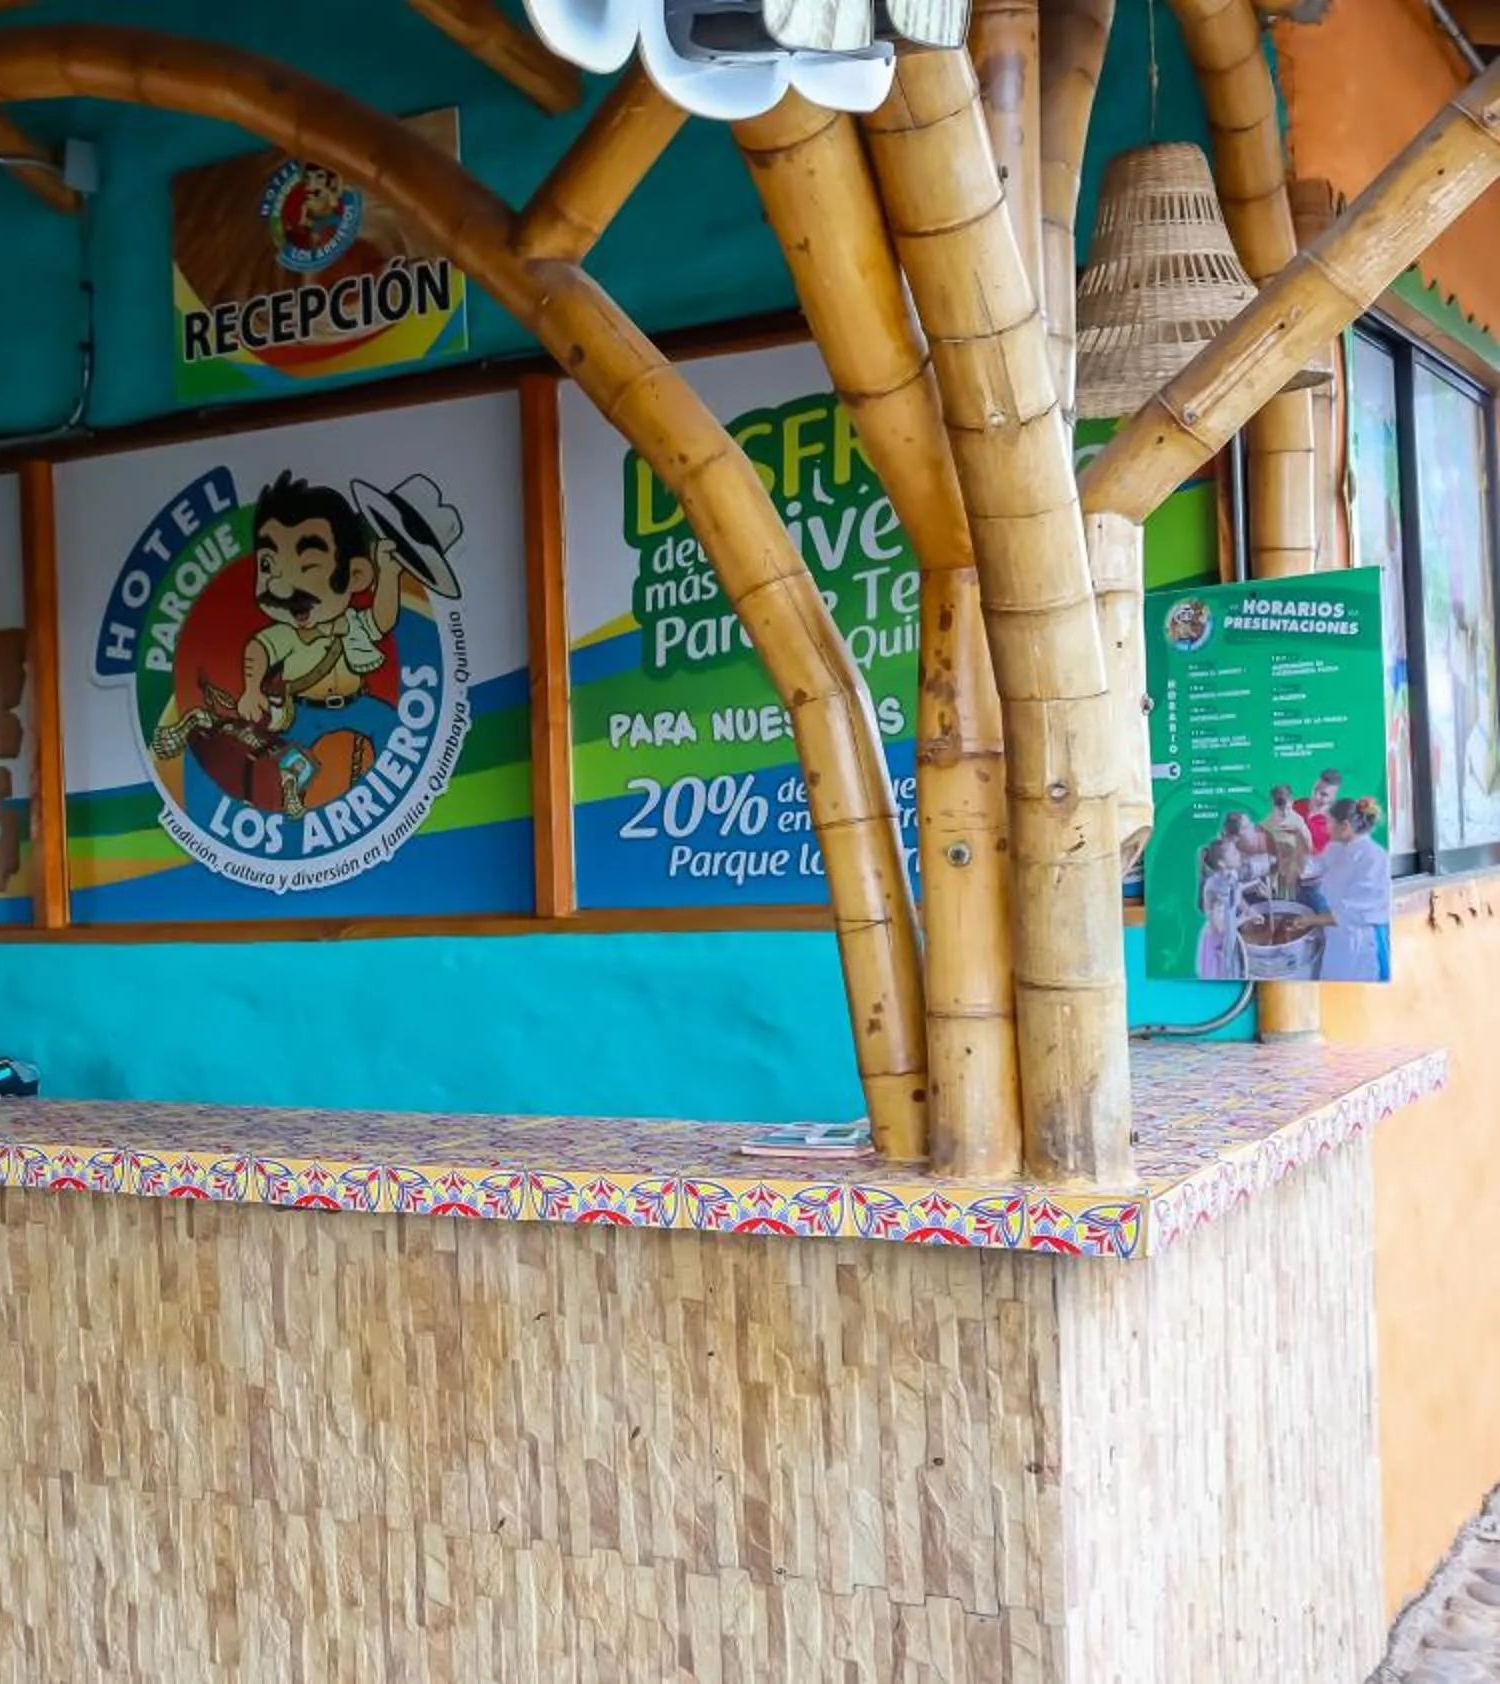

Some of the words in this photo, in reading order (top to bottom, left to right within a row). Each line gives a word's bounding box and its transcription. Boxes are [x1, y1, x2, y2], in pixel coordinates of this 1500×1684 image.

[184, 256, 451, 361] RECEPCIÓN
[105, 482, 231, 661] HOTEL
[145, 525, 241, 673] PARQUE
[645, 567, 718, 612] más
[1224, 616, 1359, 635] PRESENTACIONES
[1243, 599, 1345, 618] HORARIOS
[209, 797, 284, 854] LOS
[302, 665, 439, 854] ARRIEROS
[610, 711, 696, 749] PARA
[223, 858, 275, 885] cultura
[278, 873, 289, 888] y
[291, 858, 360, 886] diversión
[362, 847, 381, 865] en
[380, 801, 426, 855] familia
[428, 701, 468, 792] Quimbaya
[619, 774, 768, 838] 20%
[670, 845, 790, 886] Parque
